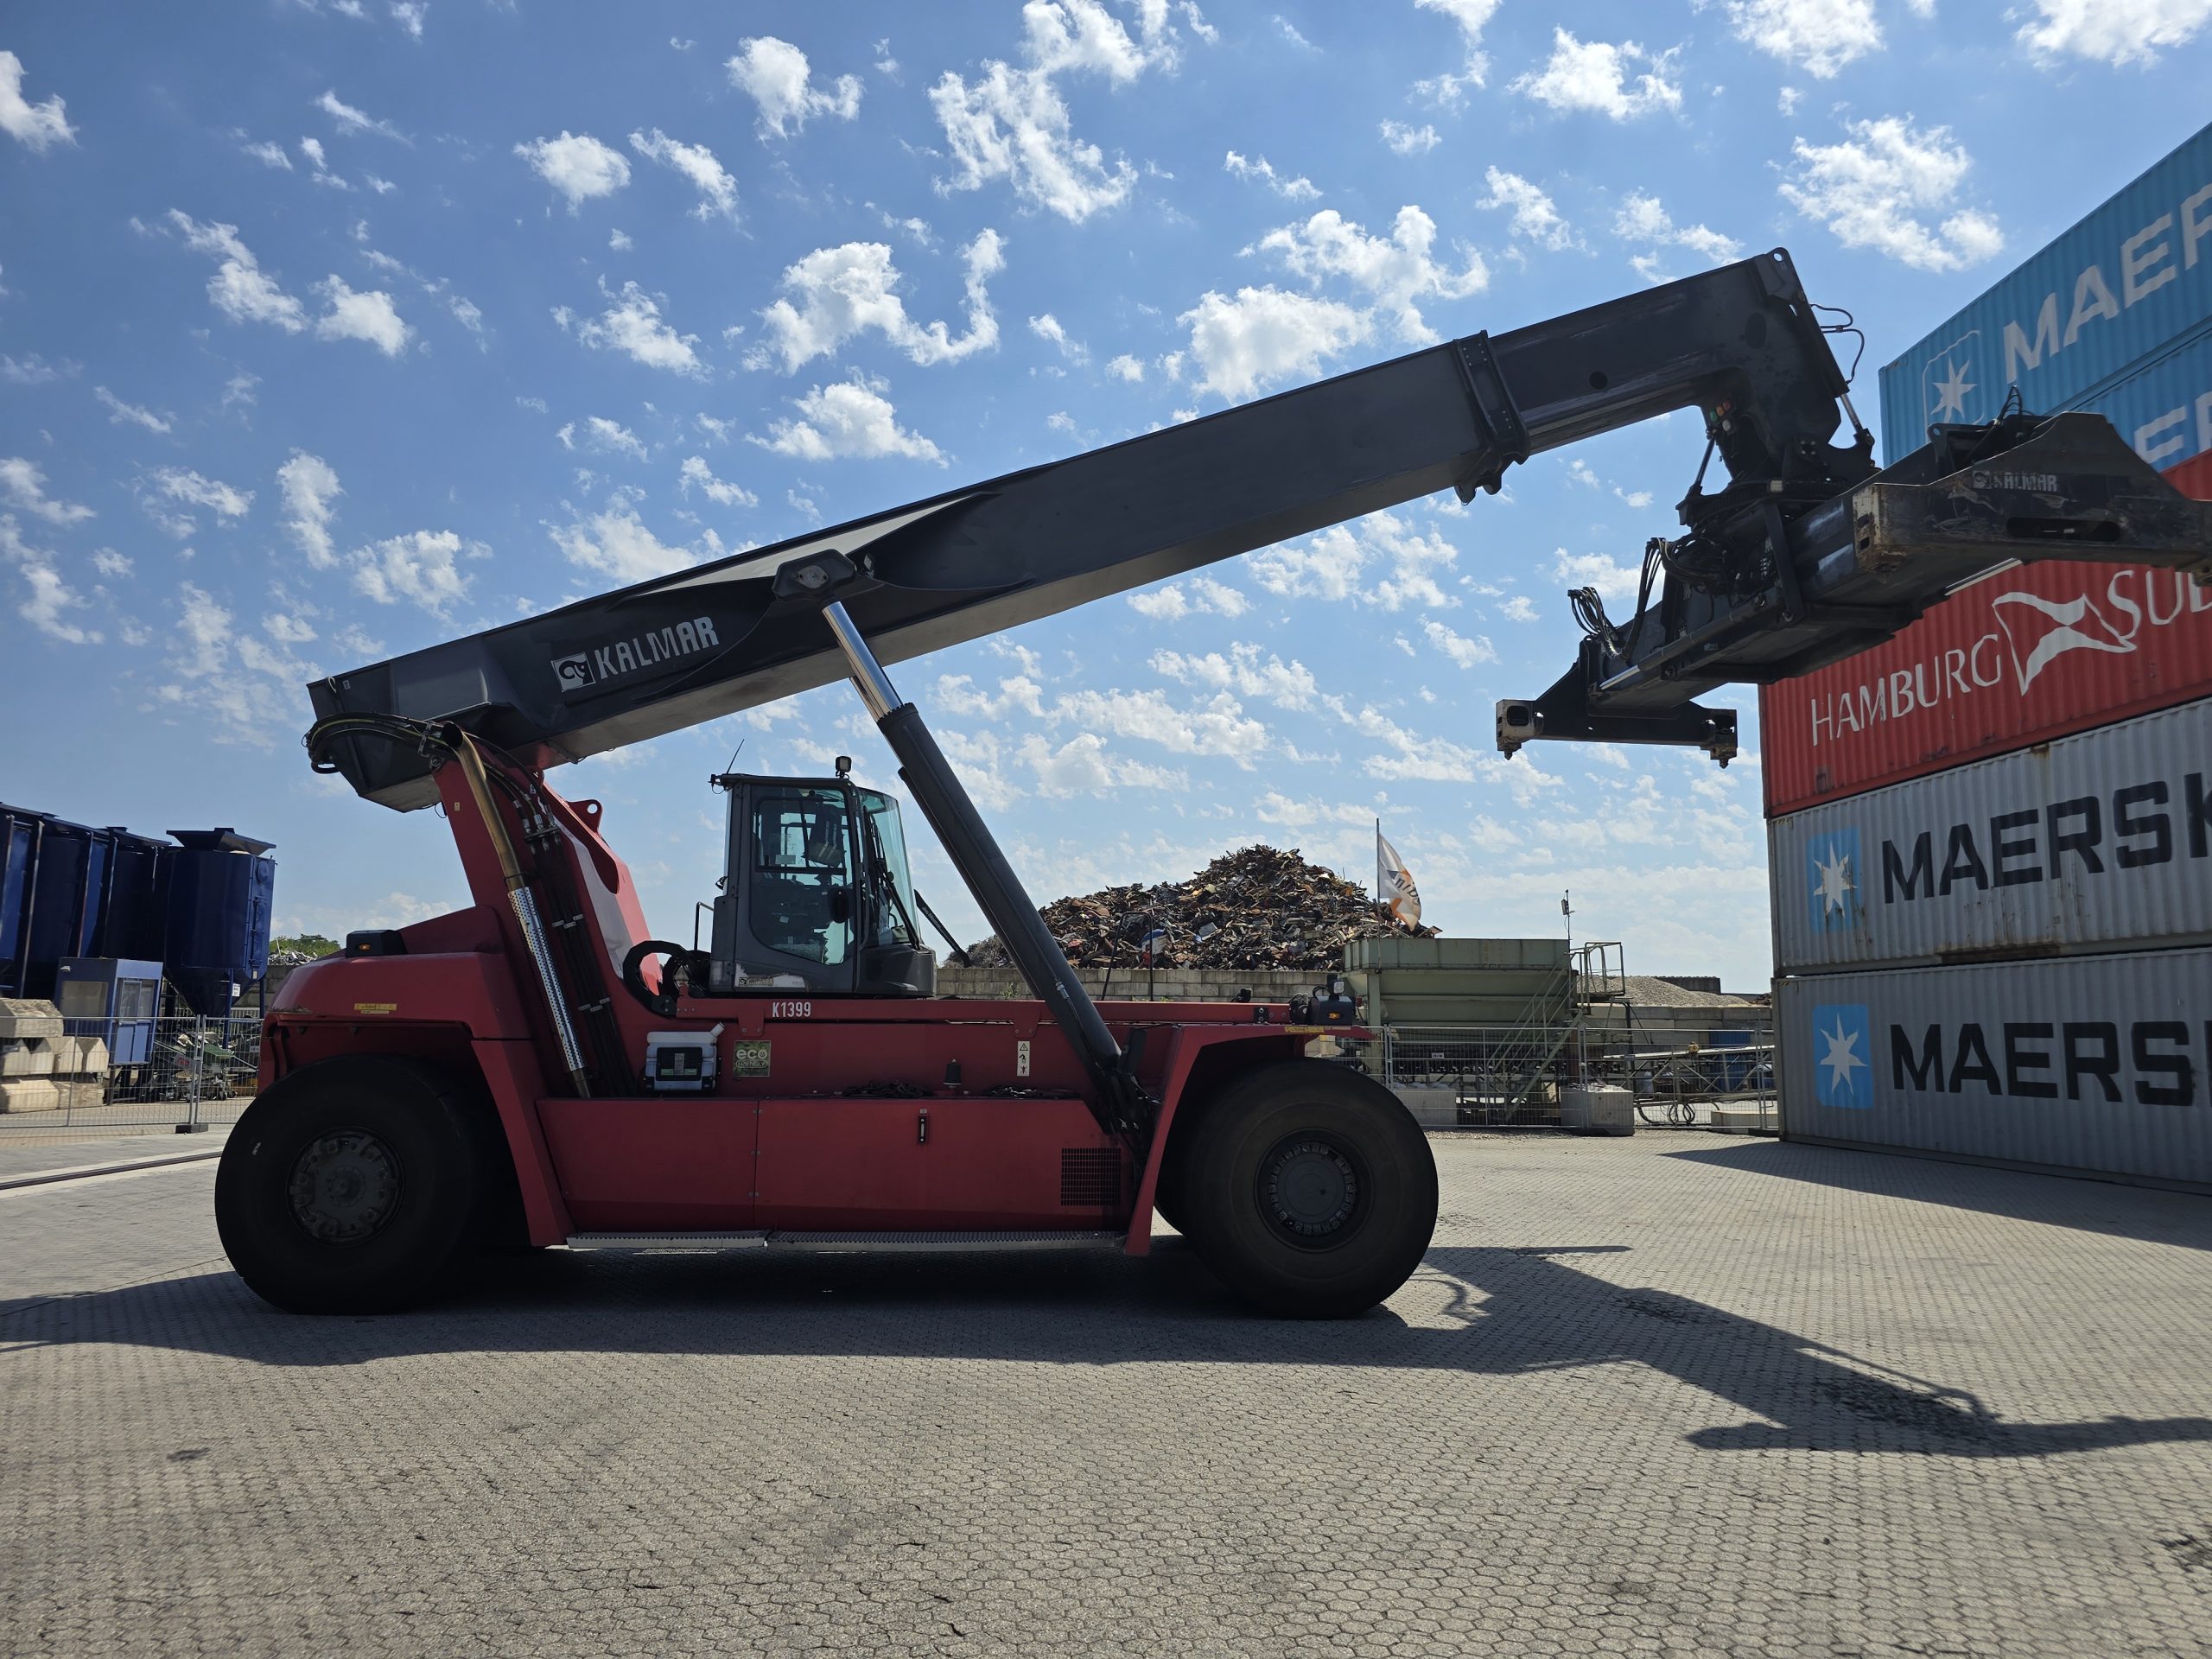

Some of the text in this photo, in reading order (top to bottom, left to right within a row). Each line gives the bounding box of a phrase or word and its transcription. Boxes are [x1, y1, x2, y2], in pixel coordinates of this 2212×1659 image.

[594, 616, 719, 679] KALMAR
[1811, 633, 2001, 746] HAMBURG
[772, 1002, 811, 1018] K1399
[736, 1049, 767, 1059] eco
[1890, 1020, 2212, 1108] MAERS
